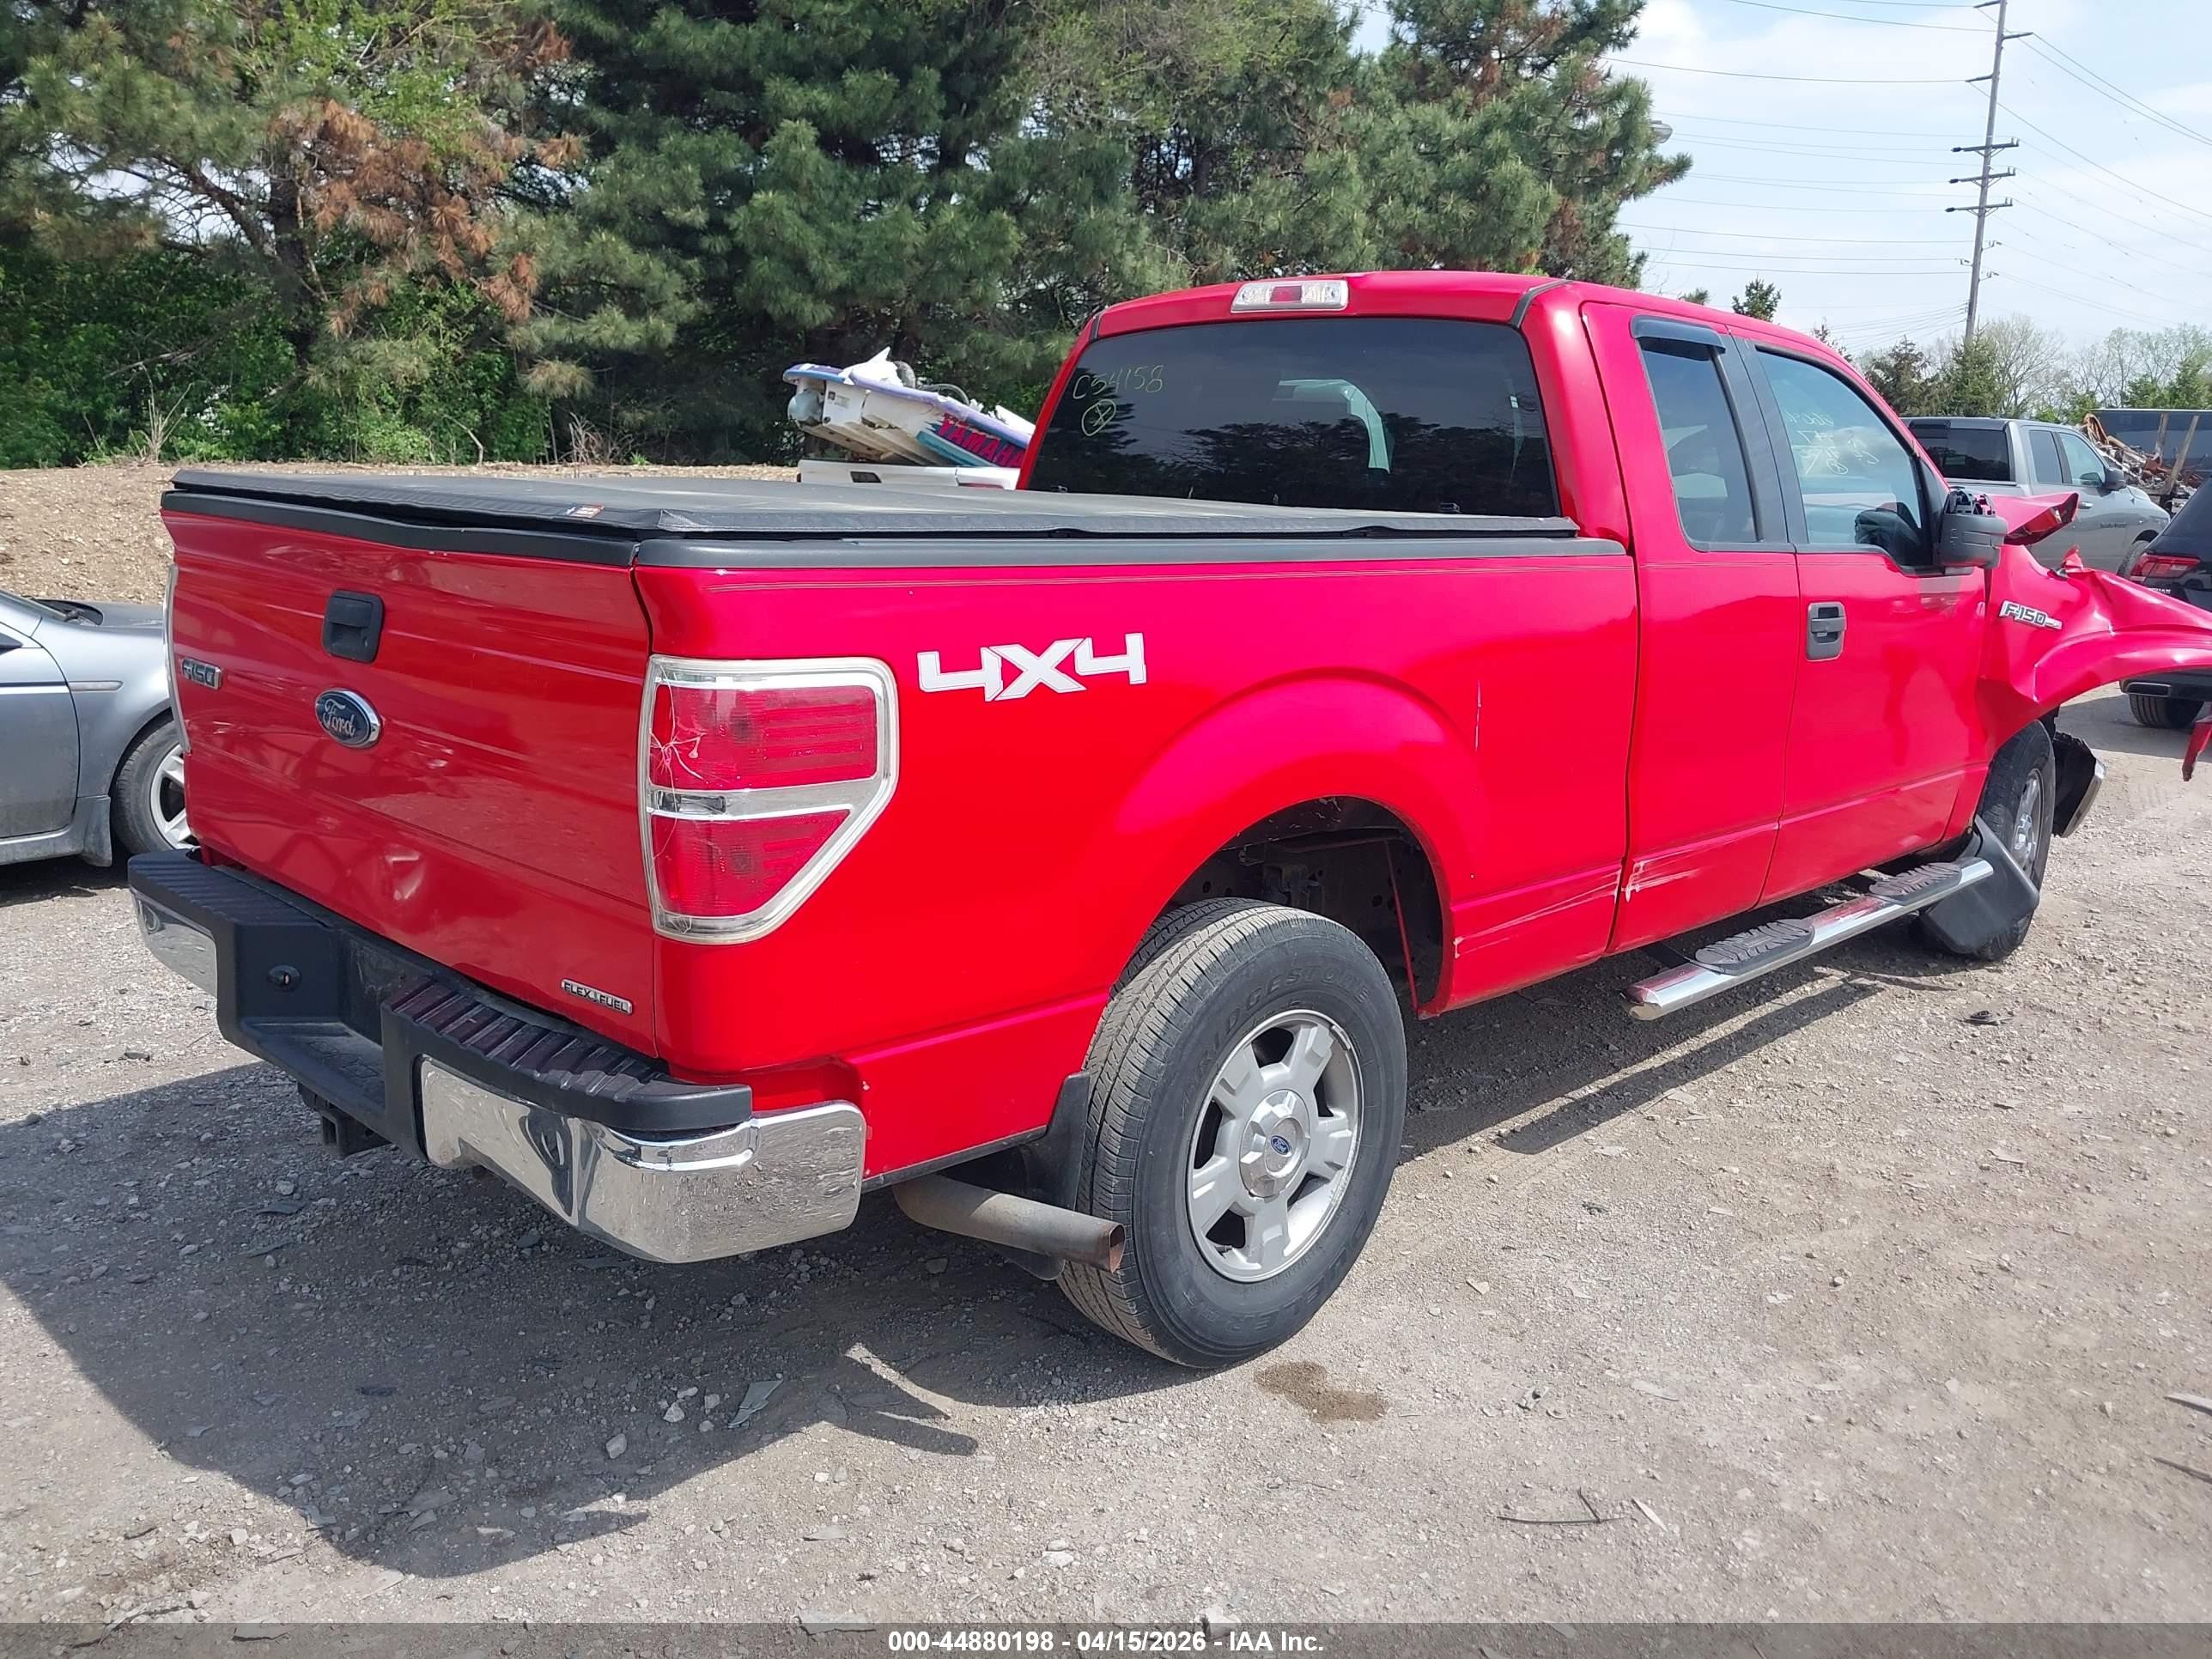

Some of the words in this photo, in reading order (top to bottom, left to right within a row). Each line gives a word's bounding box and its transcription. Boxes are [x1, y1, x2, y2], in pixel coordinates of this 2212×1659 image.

[323, 698, 357, 738] Ford
[563, 981, 592, 1000] FLEX
[599, 994, 628, 1013] FUEL
